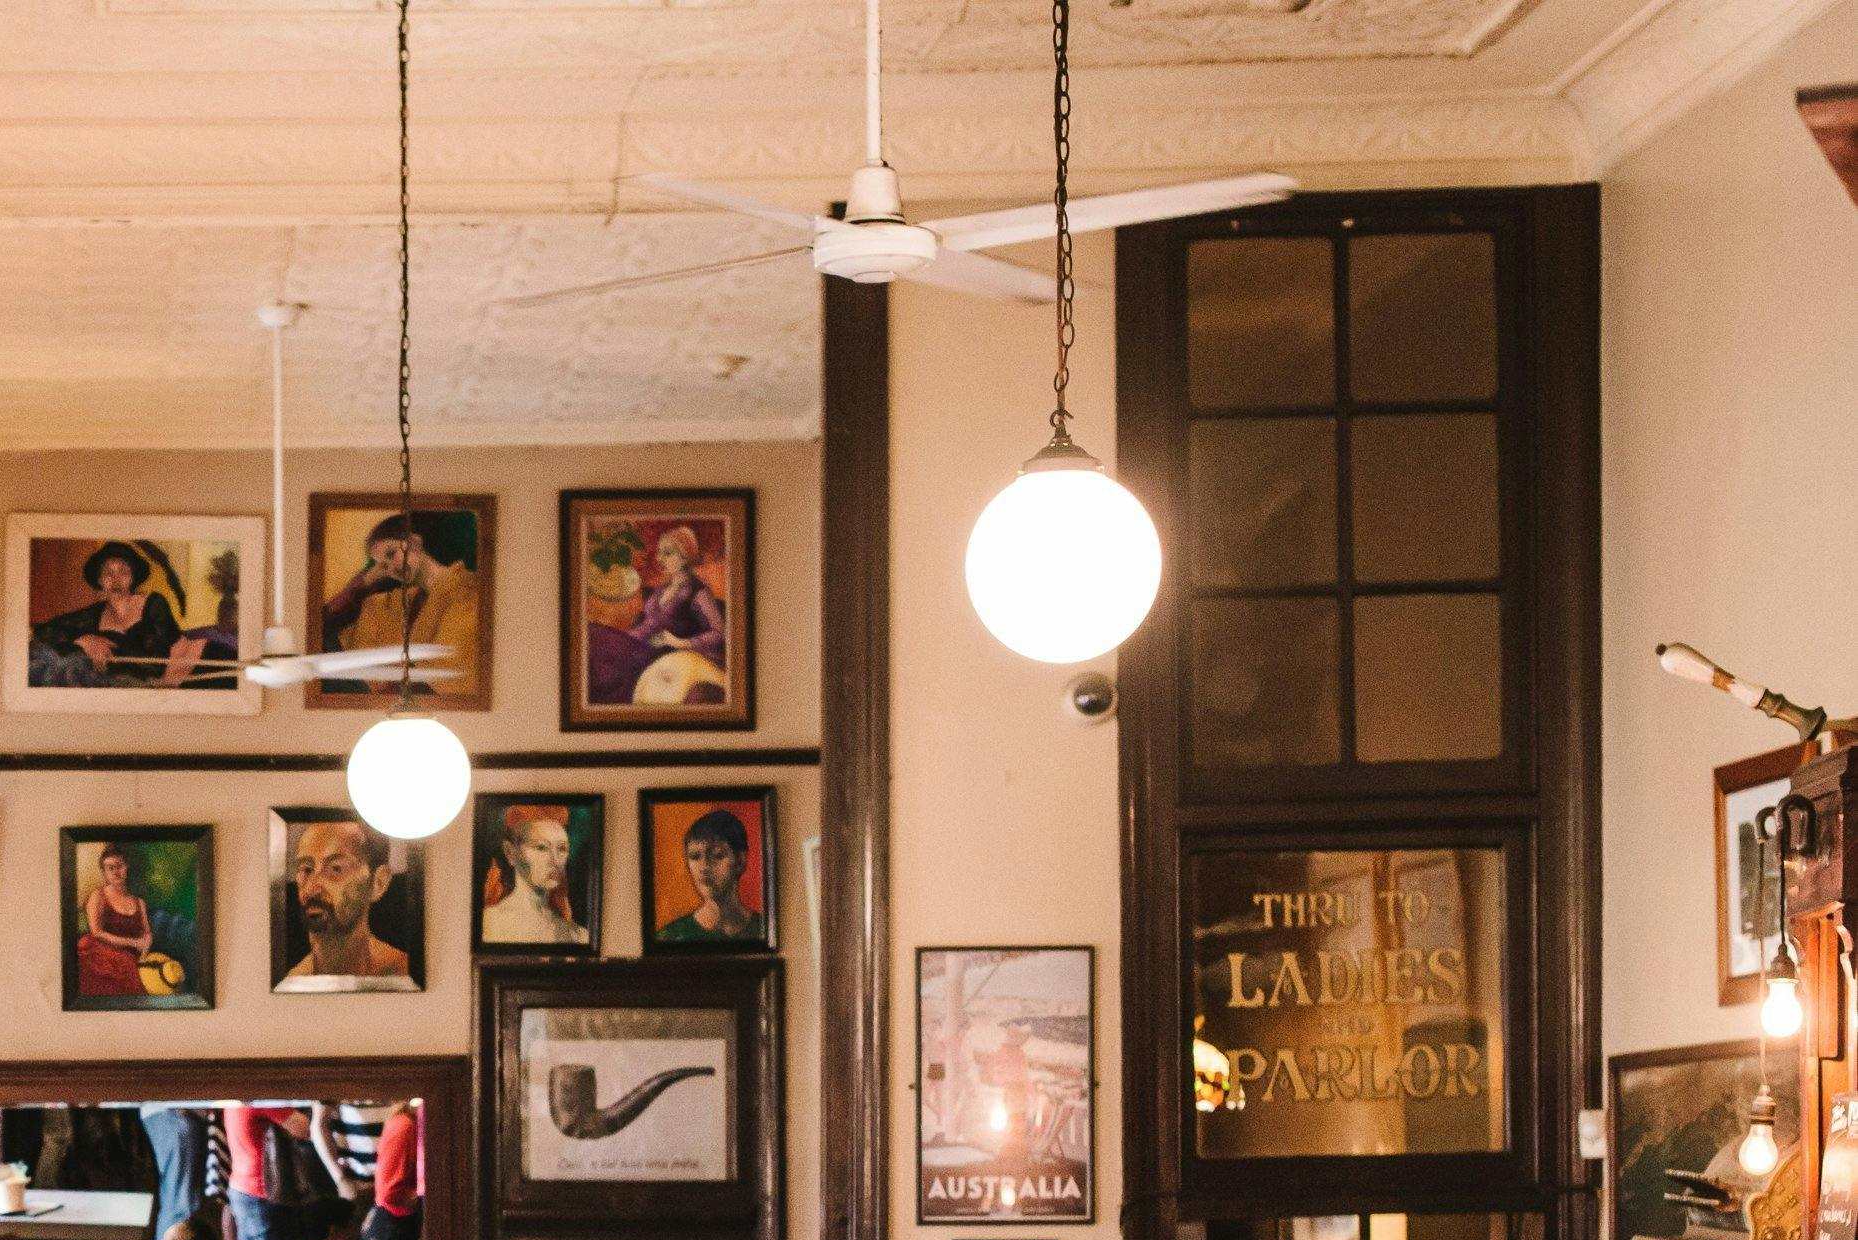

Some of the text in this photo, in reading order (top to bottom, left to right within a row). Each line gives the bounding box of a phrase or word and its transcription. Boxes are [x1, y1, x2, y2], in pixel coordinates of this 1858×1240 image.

[1253, 889, 1430, 928] THRU TO
[1227, 950, 1464, 1009] LADIES
[1226, 1044, 1480, 1102] PARLOR
[928, 1176, 1082, 1200] AUSTRALIA
